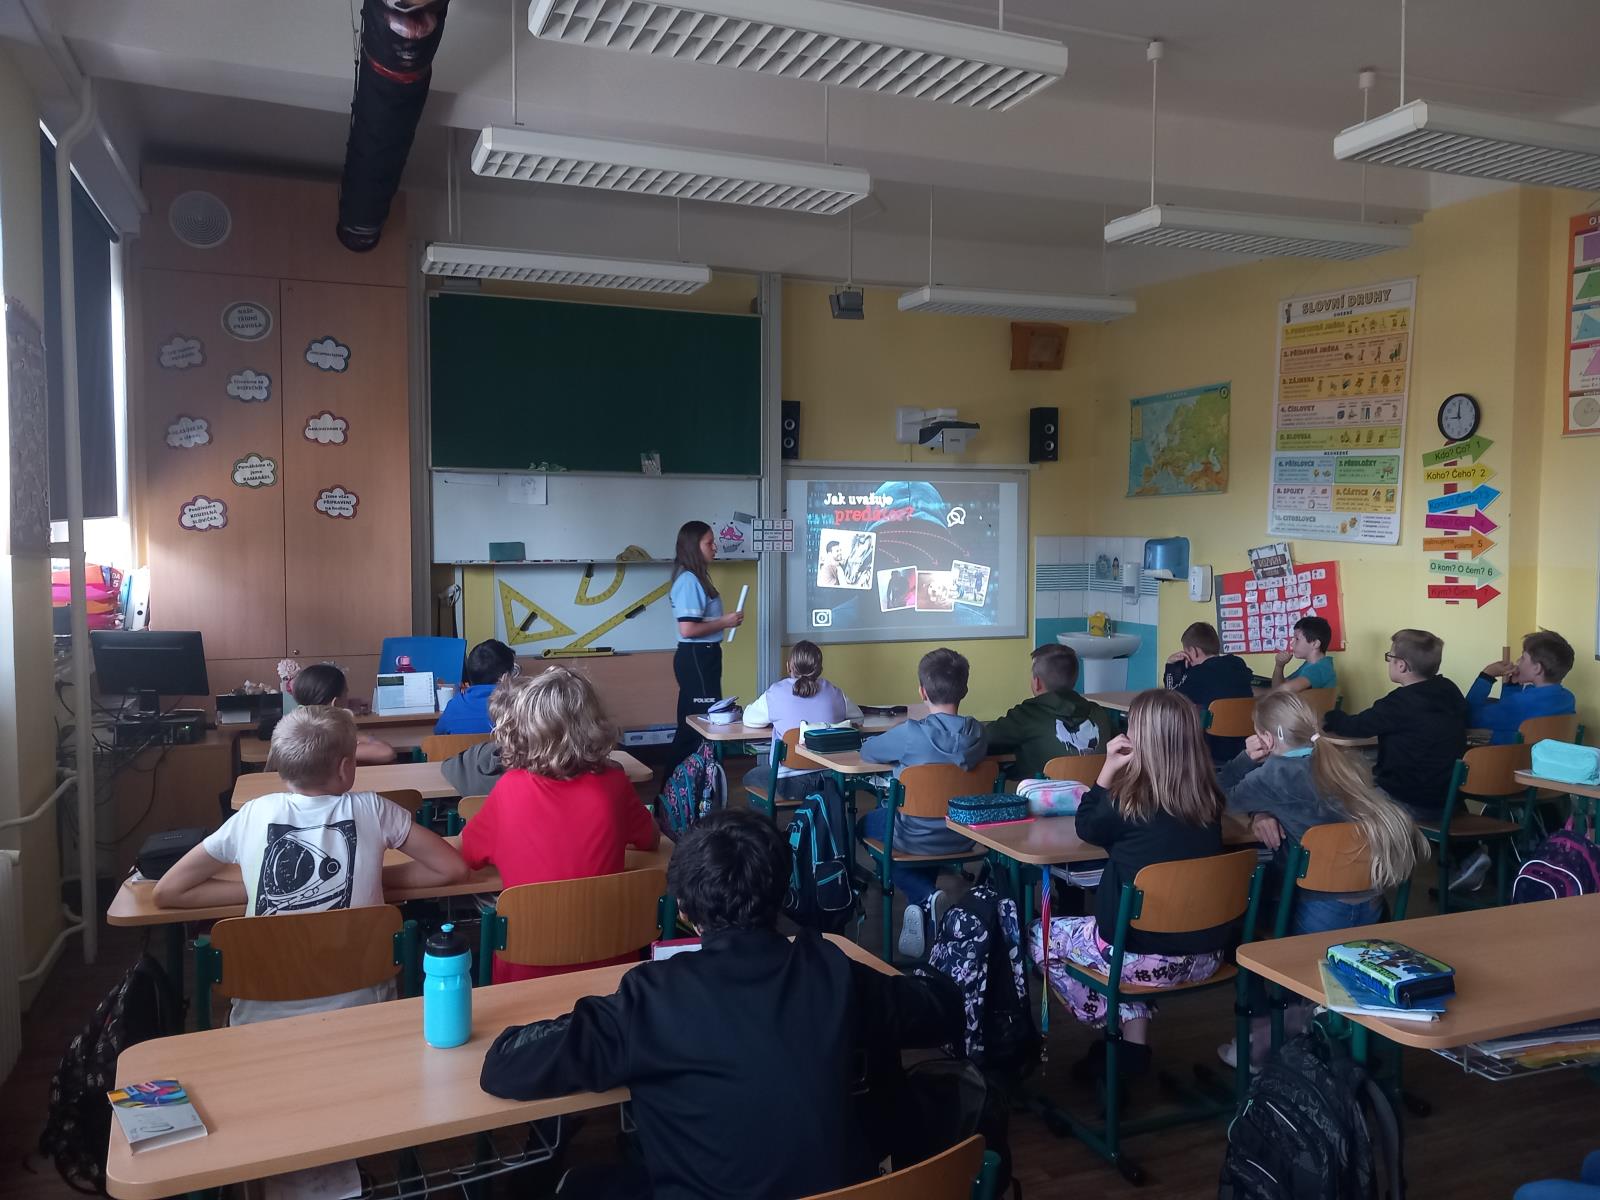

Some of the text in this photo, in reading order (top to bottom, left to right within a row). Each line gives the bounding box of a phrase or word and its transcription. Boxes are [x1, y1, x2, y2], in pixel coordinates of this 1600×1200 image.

[1302, 288, 1393, 315] SLOVNÍ DRUHY
[1288, 376, 1315, 385] ZÁJMENA
[1287, 404, 1315, 412] ČÍSLOVKY
[1434, 449, 1454, 461] Kdo?
[1456, 443, 1470, 455] Co?
[1284, 460, 1315, 468] PŘÍSLOVCE
[1344, 458, 1378, 467] PŘEDLOŽKY
[1426, 469, 1486, 480] Koho? Čeho? 2
[1342, 487, 1368, 496] ČÁSTICE
[823, 492, 894, 507] Jak uvažuje
[833, 506, 915, 526] predátor?
[1478, 540, 1483, 548] 5
[1430, 562, 1493, 576] O kom? O čem? 6
